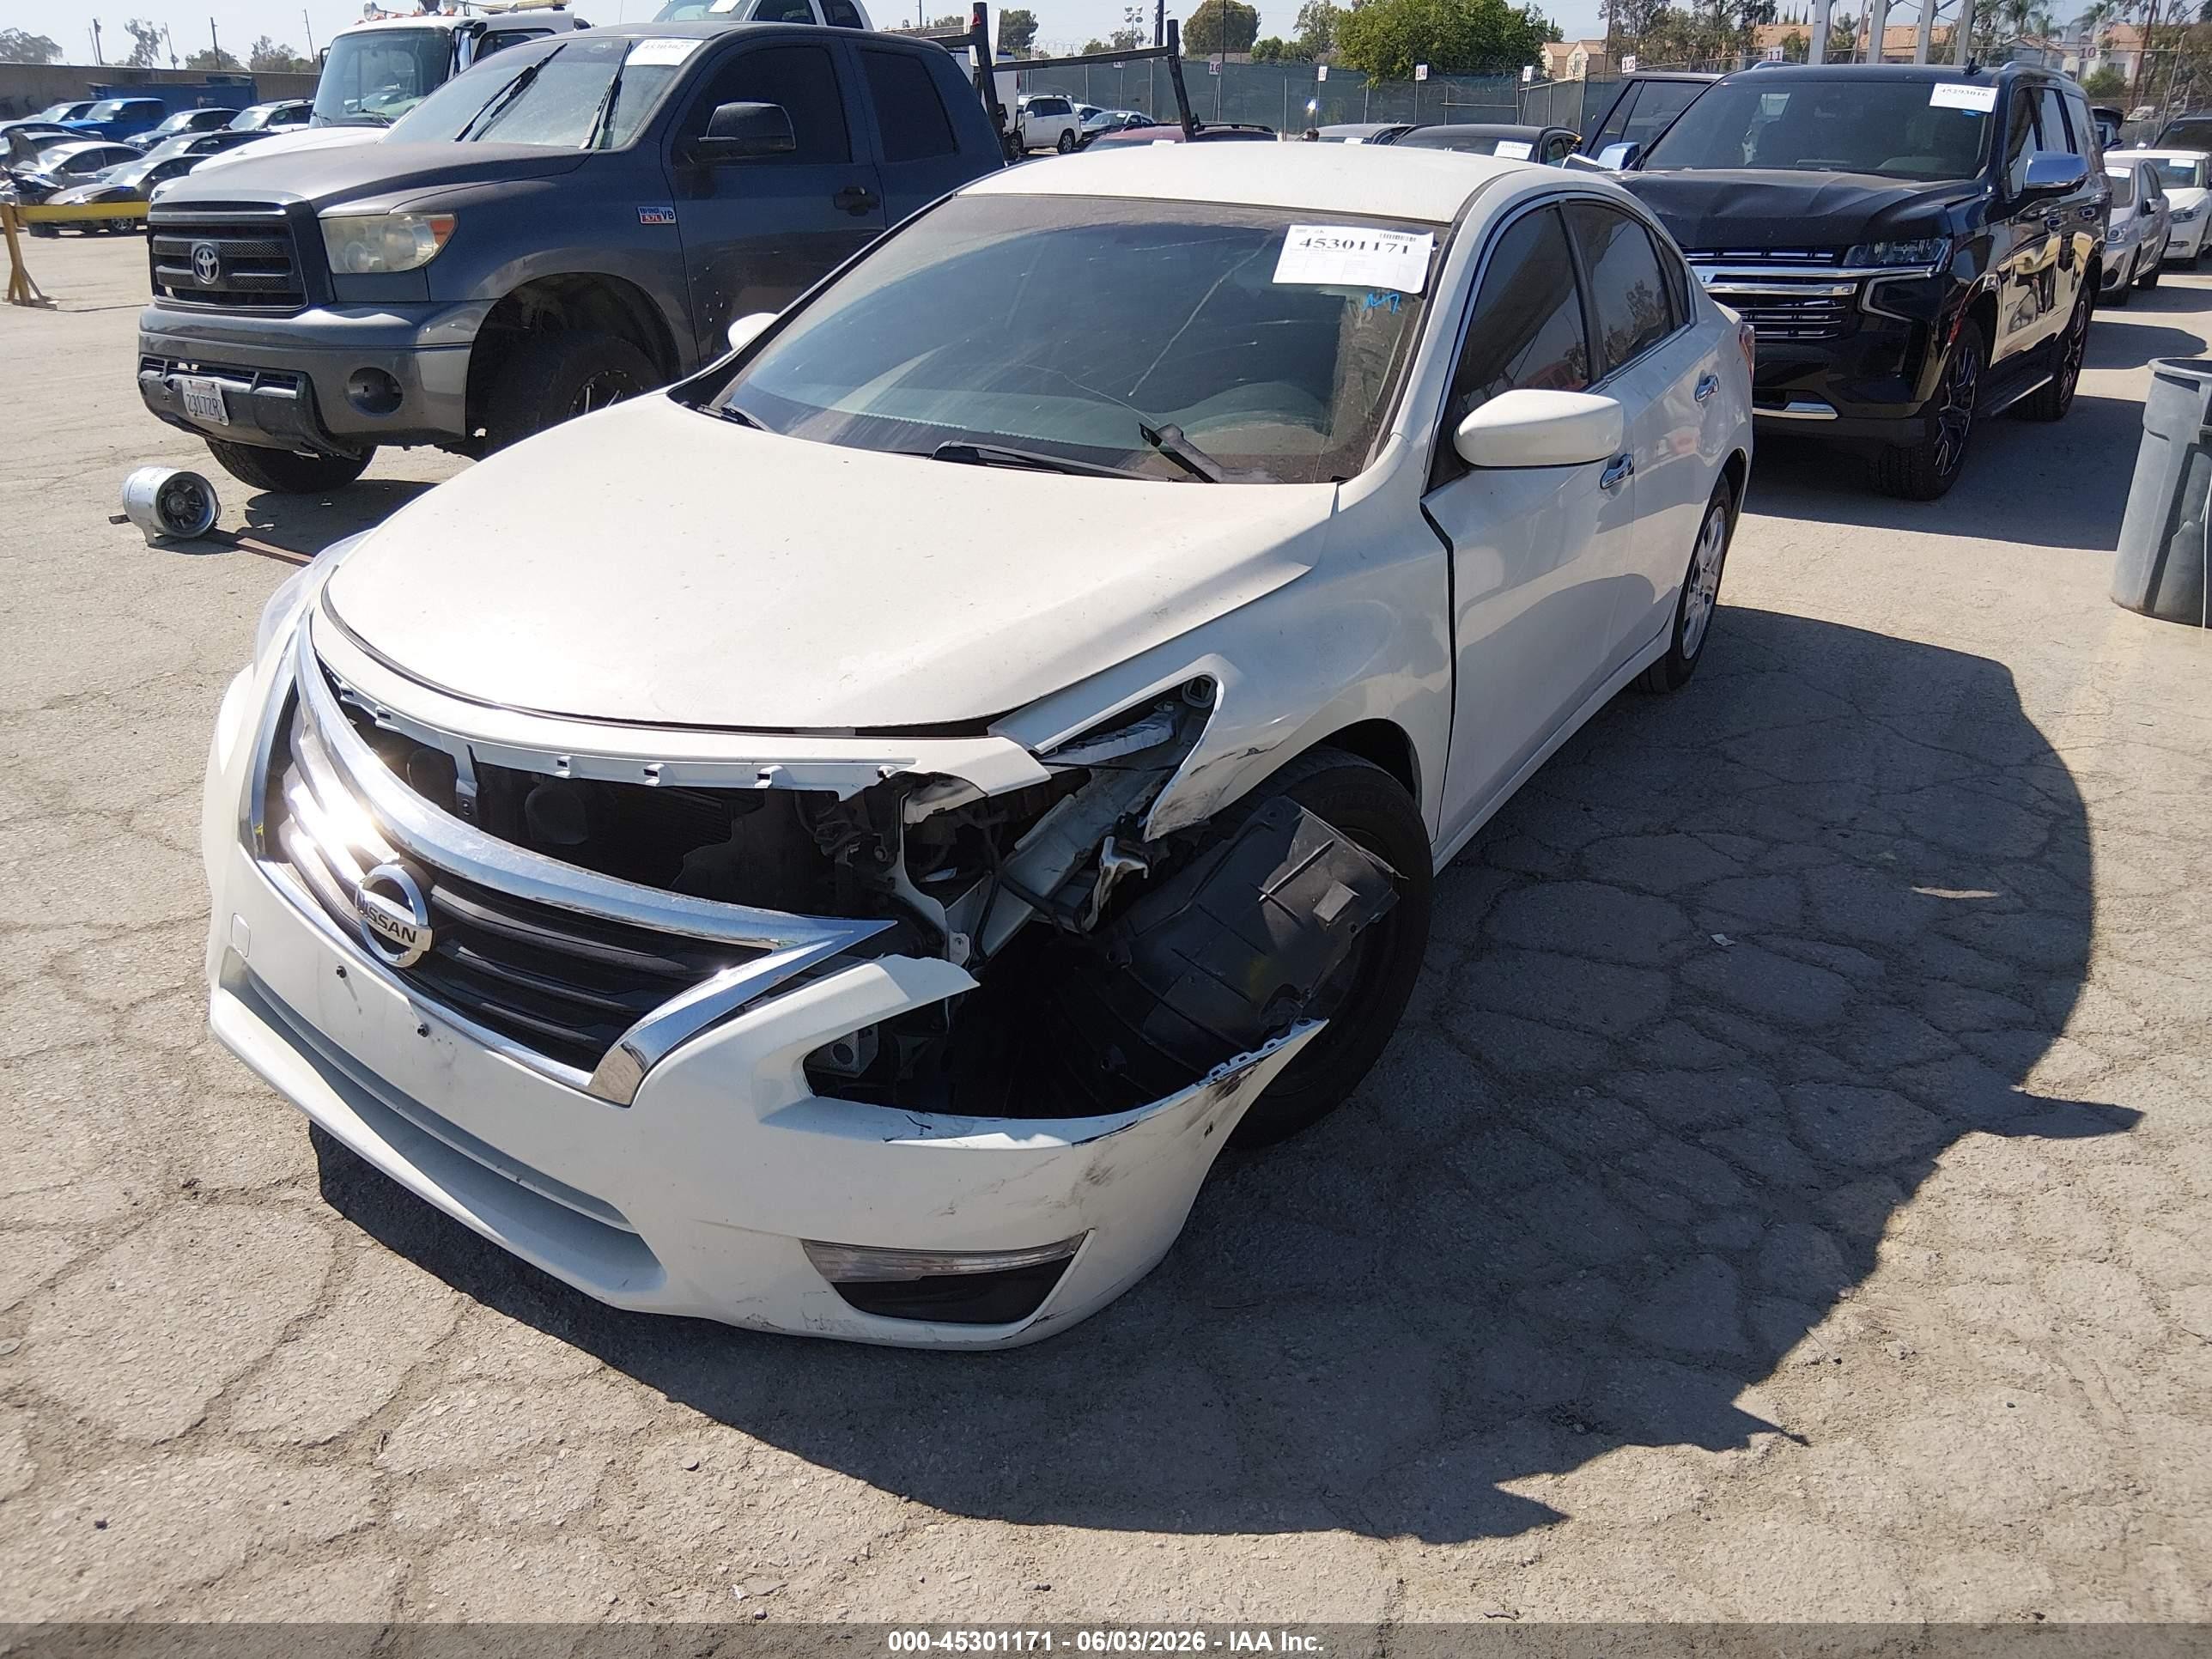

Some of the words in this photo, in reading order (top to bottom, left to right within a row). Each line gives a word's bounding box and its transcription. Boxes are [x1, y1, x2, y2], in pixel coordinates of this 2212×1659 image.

[1769, 51, 1781, 61] 11
[2079, 46, 2096, 58] 10
[1623, 59, 1635, 70] 12
[1416, 67, 1426, 77] 14
[661, 210, 675, 220] V8
[1299, 237, 1409, 255] 45301171
[356, 890, 416, 944] NISSAN
